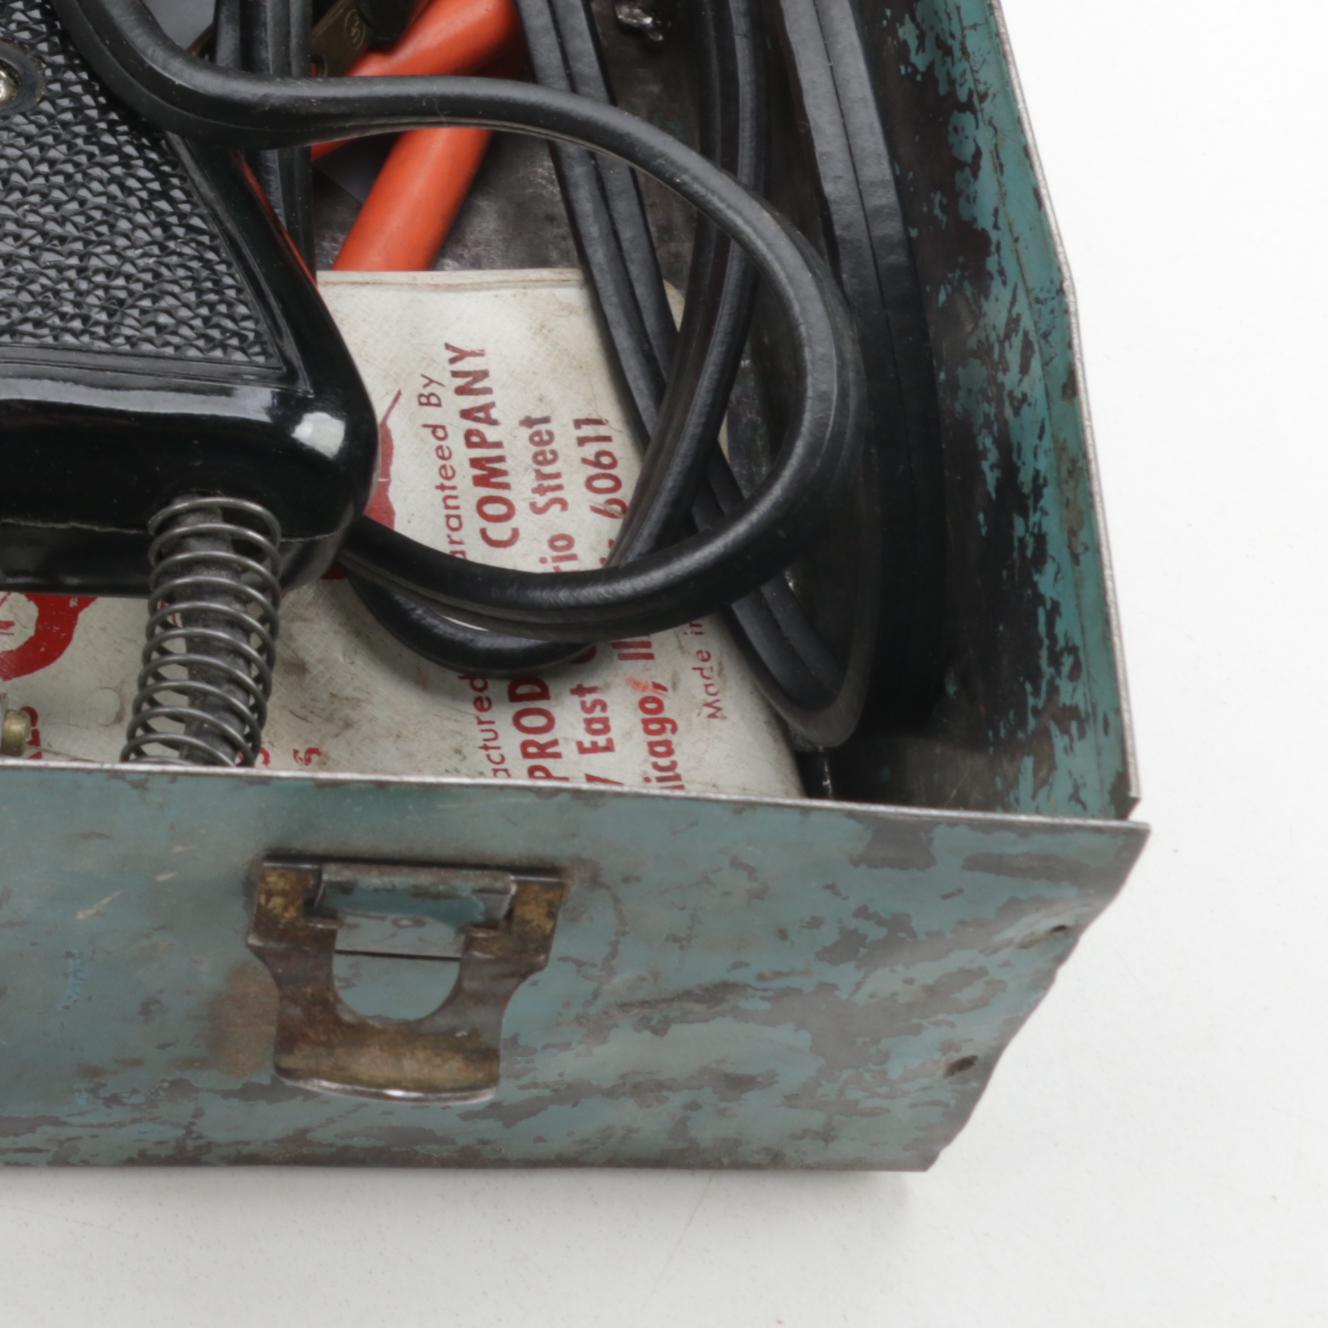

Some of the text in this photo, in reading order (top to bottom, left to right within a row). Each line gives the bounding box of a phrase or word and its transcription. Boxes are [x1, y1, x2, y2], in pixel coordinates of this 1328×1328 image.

[443, 341, 521, 549] COMPANY
[518, 415, 569, 516] Street
[572, 416, 629, 521] 60611
[569, 682, 616, 755] East
[691, 648, 728, 720] Made
